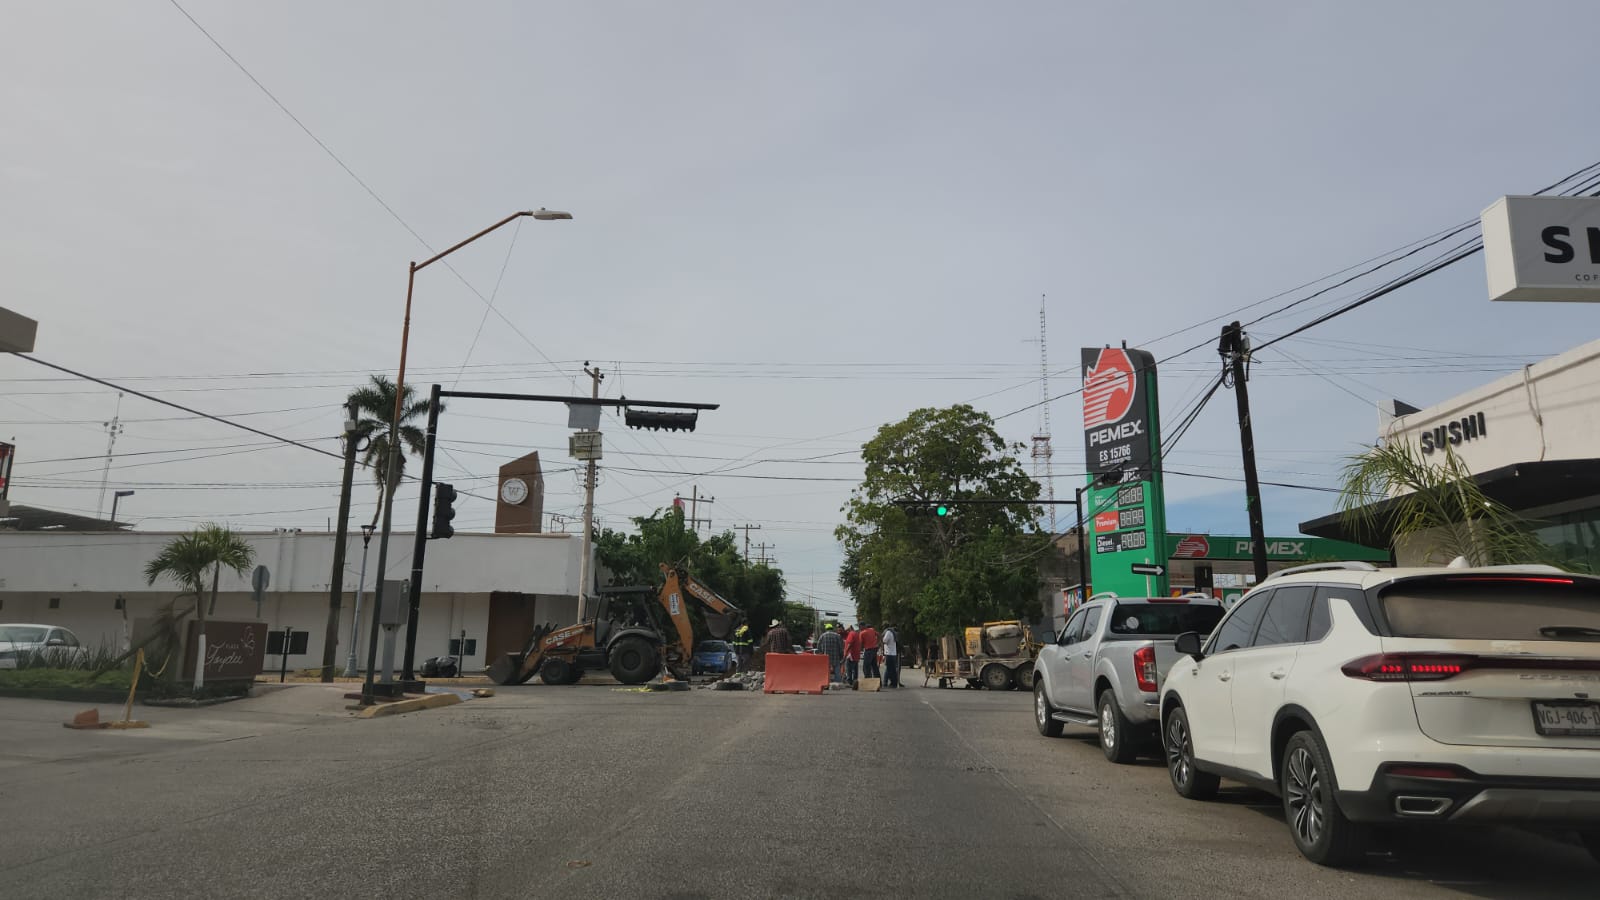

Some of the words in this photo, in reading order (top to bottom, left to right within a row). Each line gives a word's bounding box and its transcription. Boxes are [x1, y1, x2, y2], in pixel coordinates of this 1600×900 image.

[1090, 420, 1142, 447] PEMEX
[1421, 411, 1487, 455] SUSHI
[1100, 450, 1108, 462] ES
[690, 583, 715, 602] CASE
[545, 630, 571, 645] CASE
